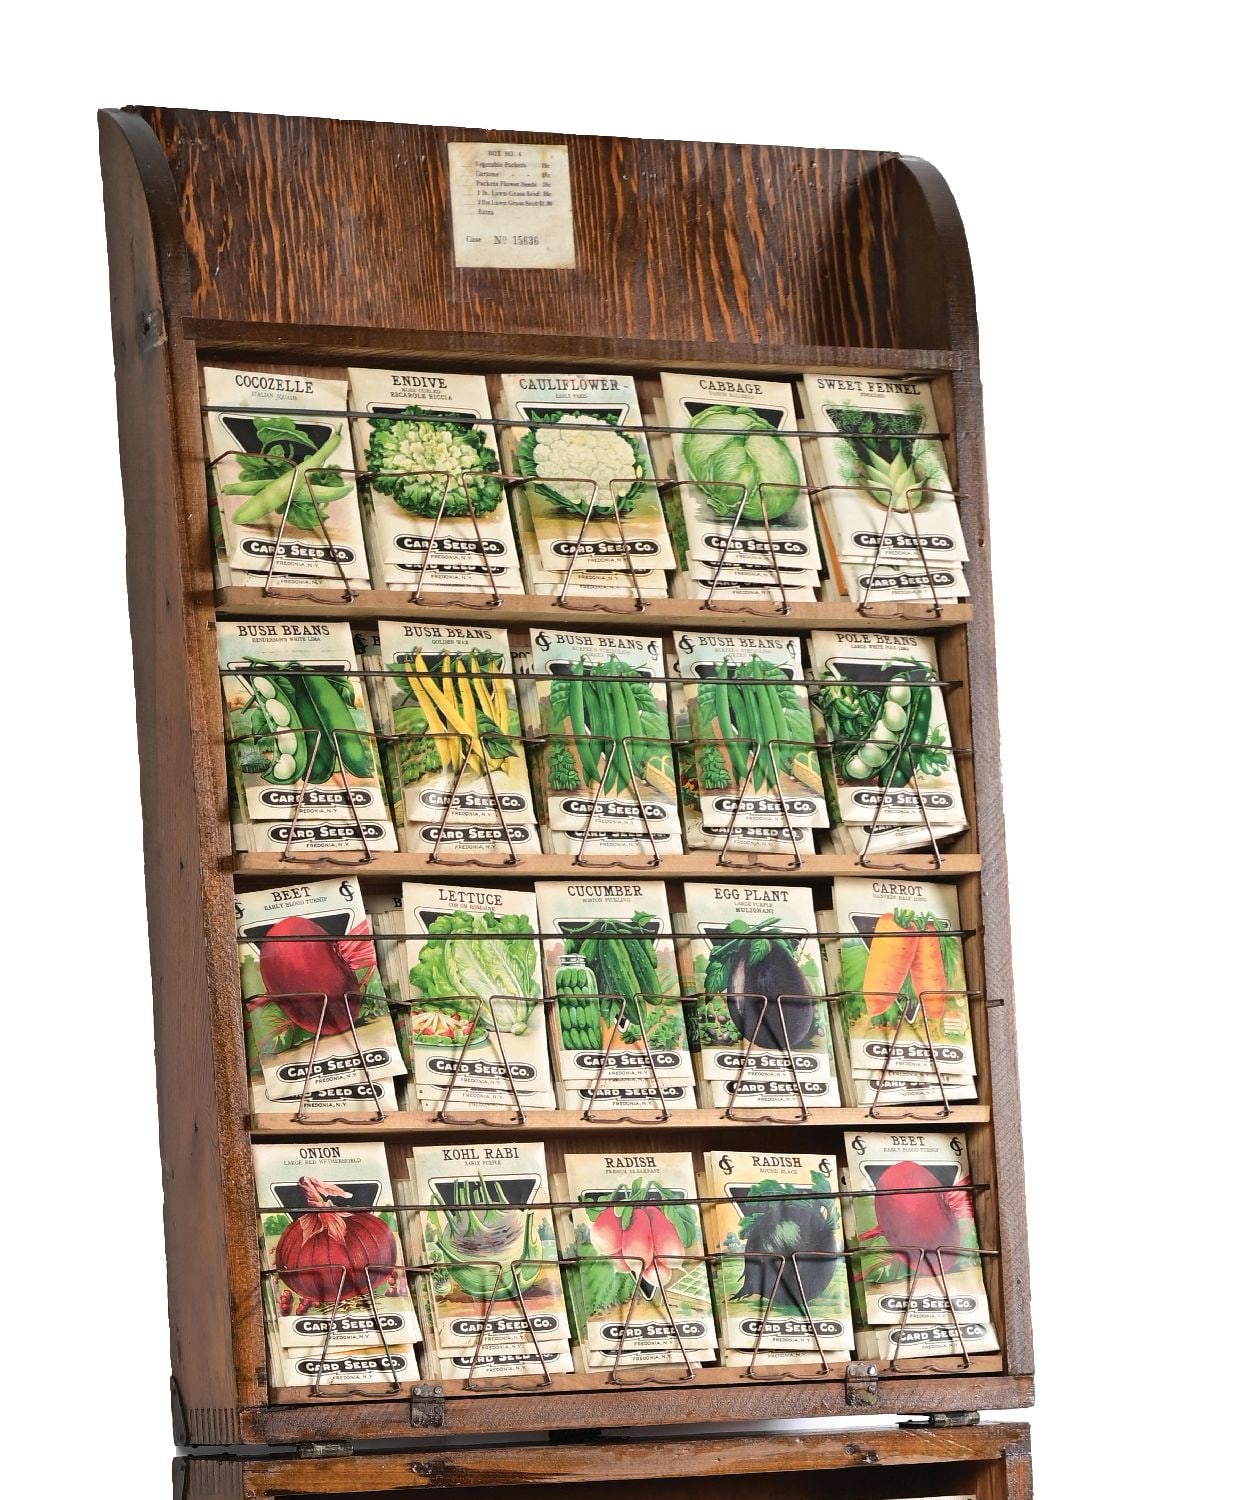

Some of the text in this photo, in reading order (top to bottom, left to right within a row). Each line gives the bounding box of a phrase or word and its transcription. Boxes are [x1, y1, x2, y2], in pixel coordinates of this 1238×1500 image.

[235, 375, 314, 394] COCOZELLE
[392, 375, 448, 389] ENDIVE
[519, 378, 620, 391] CAULIFLOWER
[699, 379, 763, 395] CABBAGE
[817, 378, 863, 391] SWEET
[867, 380, 921, 395] FENNEL
[443, 539, 477, 550] SEED
[635, 542, 654, 553] CO.
[785, 542, 804, 553] CO.
[931, 538, 950, 549] CO.
[291, 545, 324, 558] SEED
[238, 625, 330, 637] BUSH BEANS
[404, 626, 492, 640] BUSH BEANS
[556, 634, 643, 650] BUSH BEANS
[698, 635, 783, 650] BUSH BEANS
[836, 633, 873, 645] POLE
[875, 633, 918, 647] BEANS
[309, 792, 343, 803] SEED
[464, 795, 521, 807] SEED CO.
[931, 794, 949, 804] CO.
[606, 803, 664, 817] SEED CO.
[793, 802, 812, 812] CO.
[272, 886, 311, 902] BEET
[568, 885, 642, 897] CUCUMBER
[714, 888, 789, 902] EGG PLANT
[872, 883, 923, 897] CARROT
[438, 889, 503, 906] LETTUCE
[657, 1054, 676, 1064] CO.
[941, 1048, 960, 1059] CO.
[326, 1052, 385, 1071] SEED CO.
[795, 1058, 814, 1068] CO.
[473, 1063, 530, 1077] SEED CO.
[892, 1135, 925, 1147] BEET
[299, 1147, 341, 1160] ONION
[443, 1147, 520, 1161] KOHL RABI
[605, 1158, 655, 1167] RADISH
[752, 1156, 802, 1168] RADISH
[955, 1298, 973, 1309] CO.
[341, 1318, 374, 1330] SEED
[496, 1319, 552, 1331] SEED CO.
[681, 1323, 700, 1334] CO.
[819, 1323, 838, 1334] CO.
